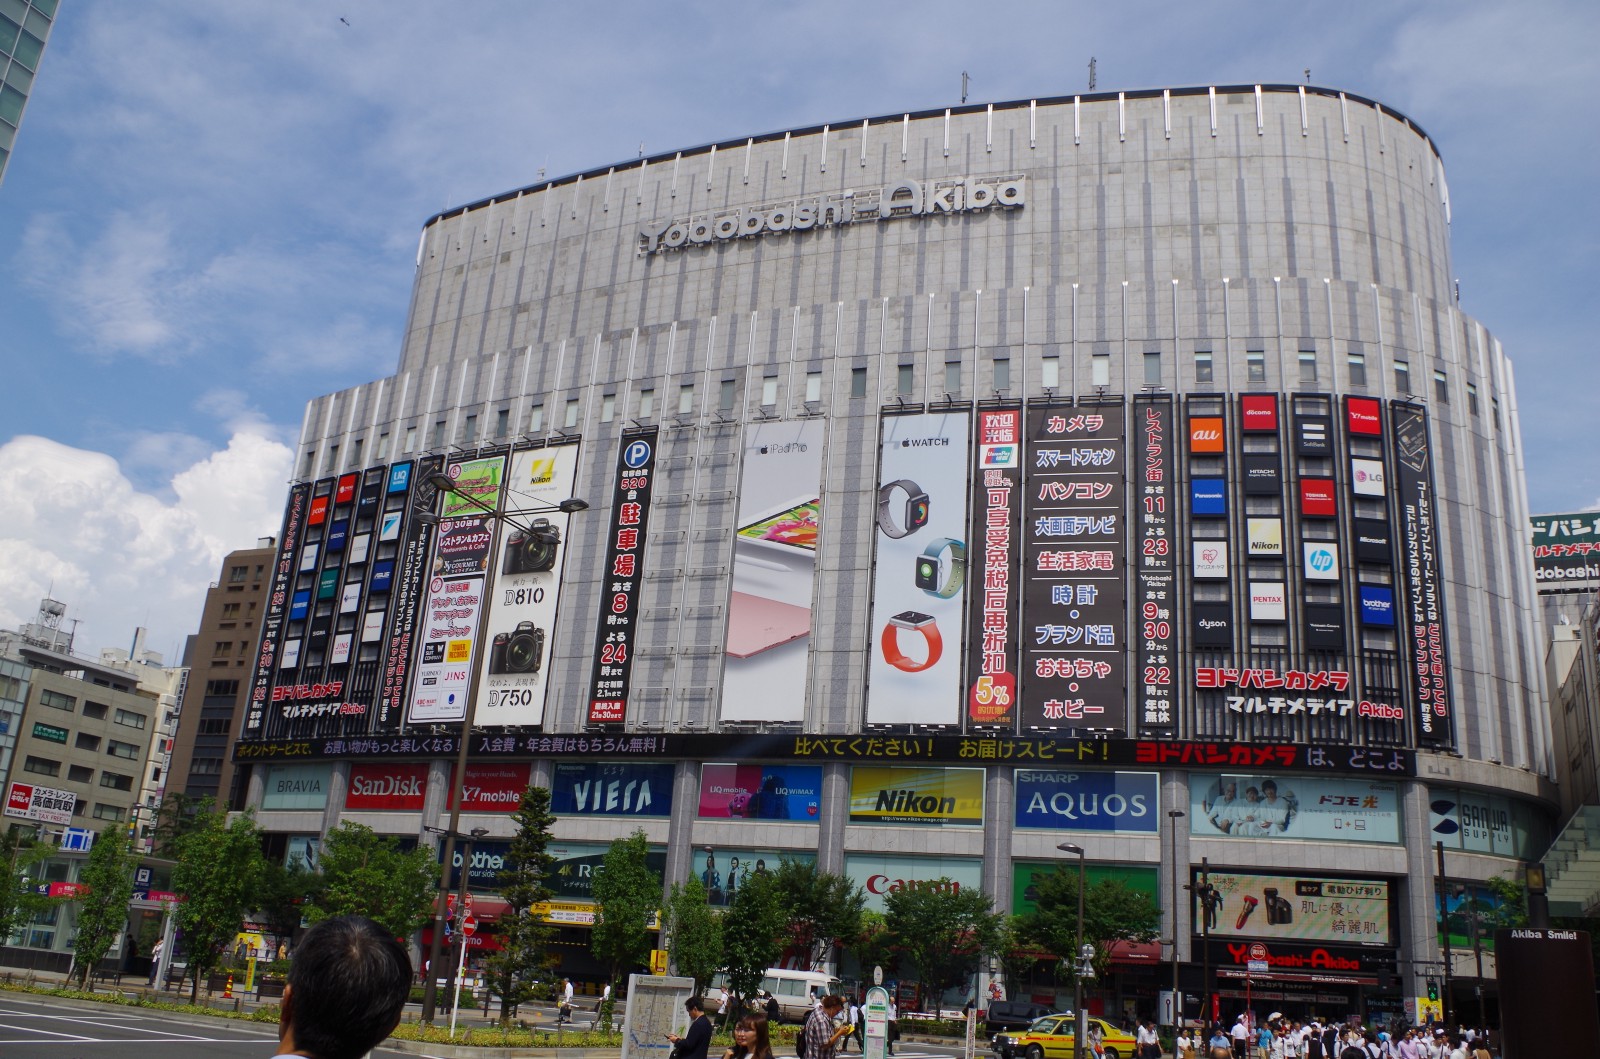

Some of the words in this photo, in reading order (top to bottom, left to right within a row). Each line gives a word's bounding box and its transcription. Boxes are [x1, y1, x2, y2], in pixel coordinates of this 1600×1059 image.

[640, 176, 1026, 252] Yodobashi-Akiba
[985, 414, 1014, 427] 欢迎
[1048, 414, 1104, 433] カメラ
[911, 438, 949, 447] WATCH
[985, 429, 1014, 442] 光临
[1192, 430, 1220, 440] au
[770, 443, 790, 454] iPad
[792, 442, 808, 452] Pro
[1146, 407, 1163, 482] レストラン街
[1037, 449, 1116, 467] スマートフォン
[621, 477, 647, 490] 520
[1038, 481, 1113, 500] パソコン
[1144, 485, 1164, 494] あさ
[627, 489, 637, 500] 台
[1143, 496, 1165, 513] 11
[1035, 515, 1116, 536] 大画面テレビ
[1144, 514, 1166, 524] 時から
[613, 502, 641, 577] 駐車場
[1145, 527, 1165, 536] よる
[1359, 536, 1386, 544] Microsoft
[1143, 538, 1169, 556] 23
[1037, 551, 1114, 571] 生活家電
[1144, 557, 1167, 567] 時まで
[1312, 550, 1332, 571] hp
[1406, 504, 1425, 622] ヨドバシカメラのポイントが
[404, 523, 427, 631] ールドポイントカード・プラスは
[982, 487, 1011, 674] 可享受免税后再折扣
[612, 581, 632, 592] あさ
[1052, 585, 1098, 605] 時計
[272, 592, 285, 605] 23
[504, 588, 544, 606] D810
[612, 593, 628, 613] 8
[1146, 591, 1166, 600] あさ
[1362, 599, 1391, 608] brother
[1417, 481, 1437, 621] ゴールドポイントカード・プラスは
[1428, 623, 1446, 717] どこで使っても
[1143, 602, 1170, 620] 9時
[607, 615, 628, 625] 時から
[1199, 618, 1226, 629] dyson
[606, 632, 626, 642] よる
[1035, 625, 1115, 646] ブランド品
[1143, 621, 1170, 640] 30
[600, 643, 627, 664] 24
[1145, 640, 1168, 651] 分から
[260, 654, 273, 667] 30
[1147, 655, 1167, 664] よる
[1415, 625, 1431, 700] ジャンジャン
[601, 666, 622, 676] 時まで
[1036, 658, 1111, 679] おもちゃ
[1143, 667, 1170, 685] 22
[1196, 668, 1350, 692] ヨドバシカメラ
[253, 687, 266, 700] 22
[272, 681, 343, 701] ヨドバシカメラ
[488, 689, 532, 707] D750
[976, 676, 1009, 704] 5%
[1146, 686, 1169, 696] 時まで
[283, 703, 341, 718] マルチメディア
[340, 703, 366, 714] Akiba
[1043, 699, 1104, 719] ホビー
[1144, 699, 1169, 711] 年中
[1226, 696, 1354, 716] マルチメディア
[1358, 700, 1404, 719] Akiba
[1144, 711, 1170, 723] 無休
[1421, 703, 1432, 732] 貯まる
[479, 737, 667, 753] 入会費・年会費はもちろん無料！
[794, 737, 933, 756] 比べてください！
[959, 739, 1108, 760] お届けスピード！
[1136, 742, 1297, 766] ヨドバシカメラ
[277, 780, 320, 792] BRAVIA
[352, 776, 422, 796] SanDisk
[1019, 772, 1079, 783] SHARP
[32, 795, 74, 812] 高価買取
[874, 789, 956, 815] Nikon
[1026, 791, 1147, 820] AQUOS
[1462, 804, 1508, 832] SANWA
[1463, 828, 1510, 843] SUPPLY
[481, 869, 495, 877] side
[557, 864, 572, 876] 4K
[1301, 900, 1359, 916] 肌に優しく
[1331, 920, 1379, 934] 綺麗肌
[1511, 929, 1542, 939] Akiba
[1547, 931, 1577, 940] Smile!
